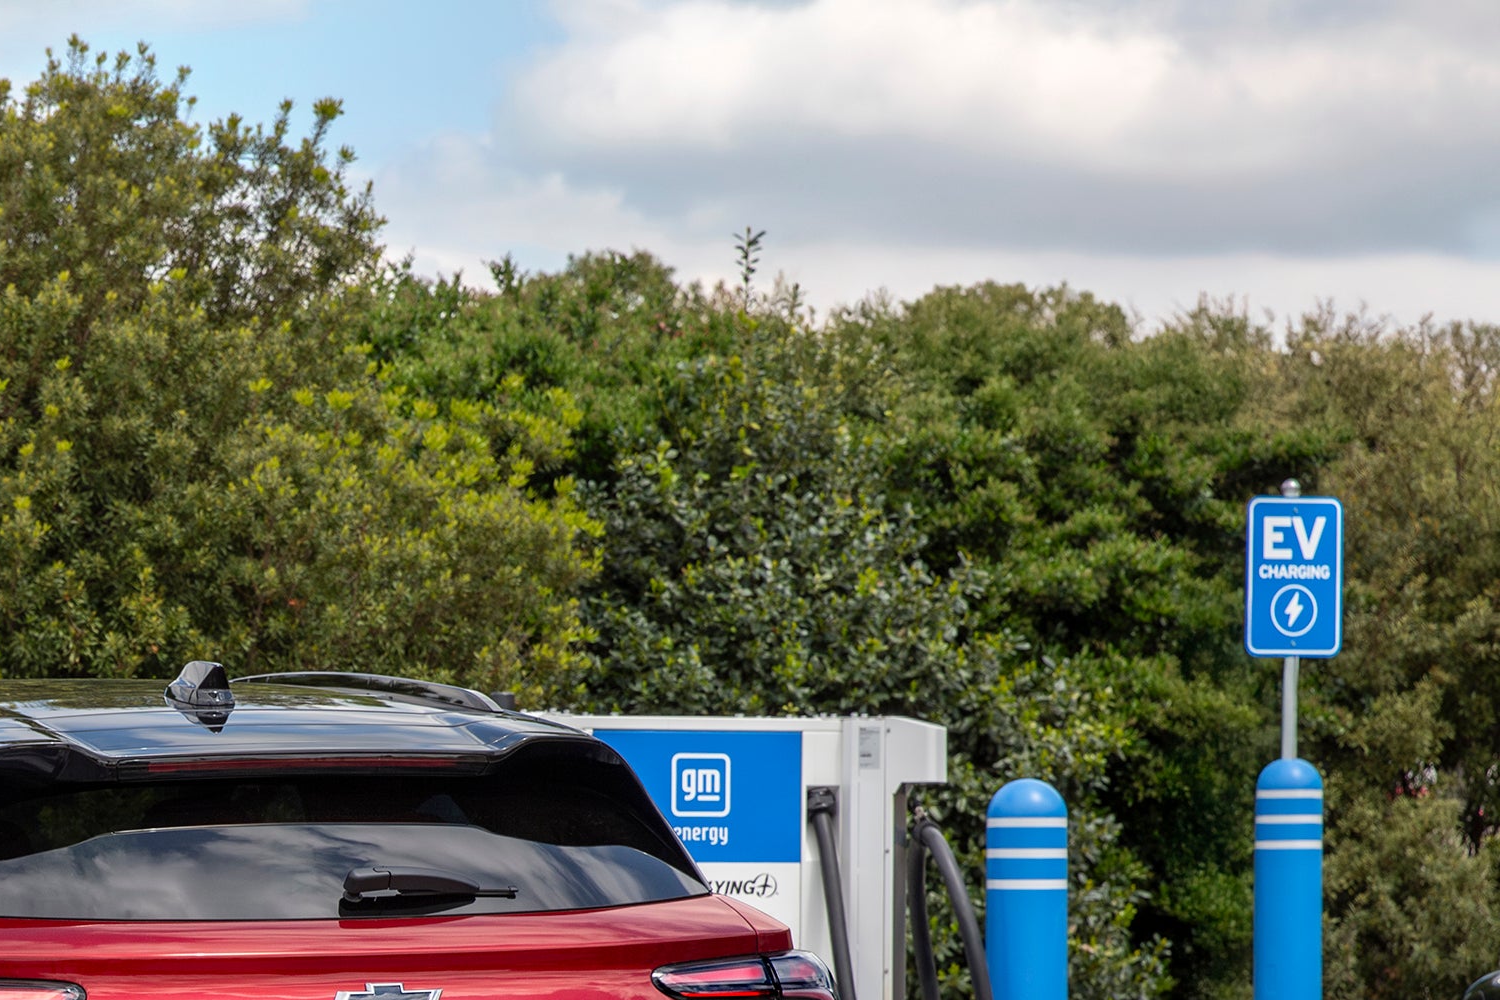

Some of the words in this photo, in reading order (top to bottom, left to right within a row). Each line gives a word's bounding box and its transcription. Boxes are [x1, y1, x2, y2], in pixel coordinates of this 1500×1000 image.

[1263, 515, 1327, 560] EV
[1258, 564, 1330, 579] CHARGING
[681, 768, 721, 802] gm
[709, 880, 756, 897] YING
